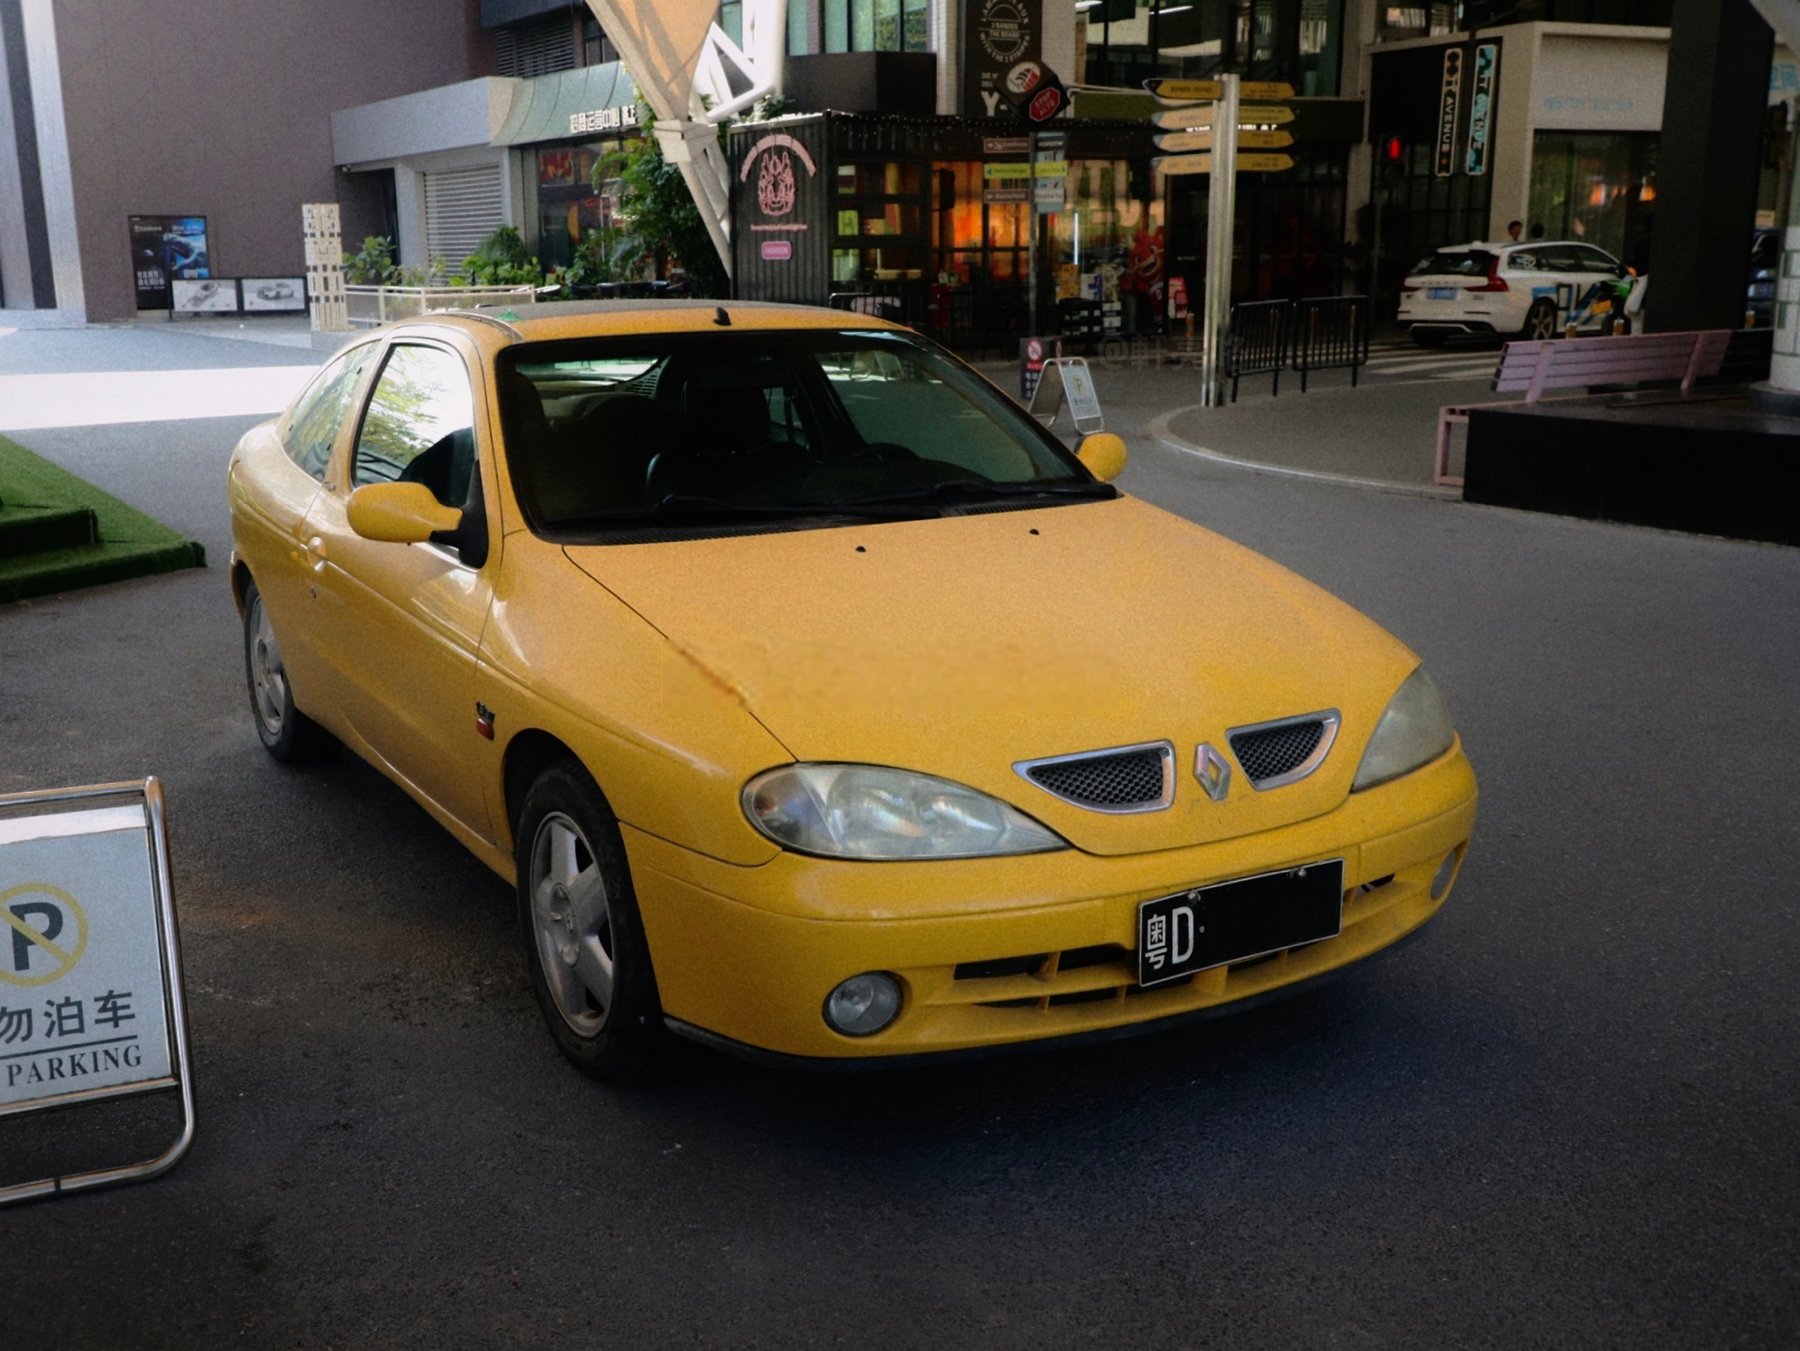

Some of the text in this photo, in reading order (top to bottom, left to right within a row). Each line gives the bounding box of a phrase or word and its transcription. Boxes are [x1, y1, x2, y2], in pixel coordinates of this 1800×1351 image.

[0, 990, 136, 1044] 勿泊车
[8, 1044, 142, 1087] PARKING
